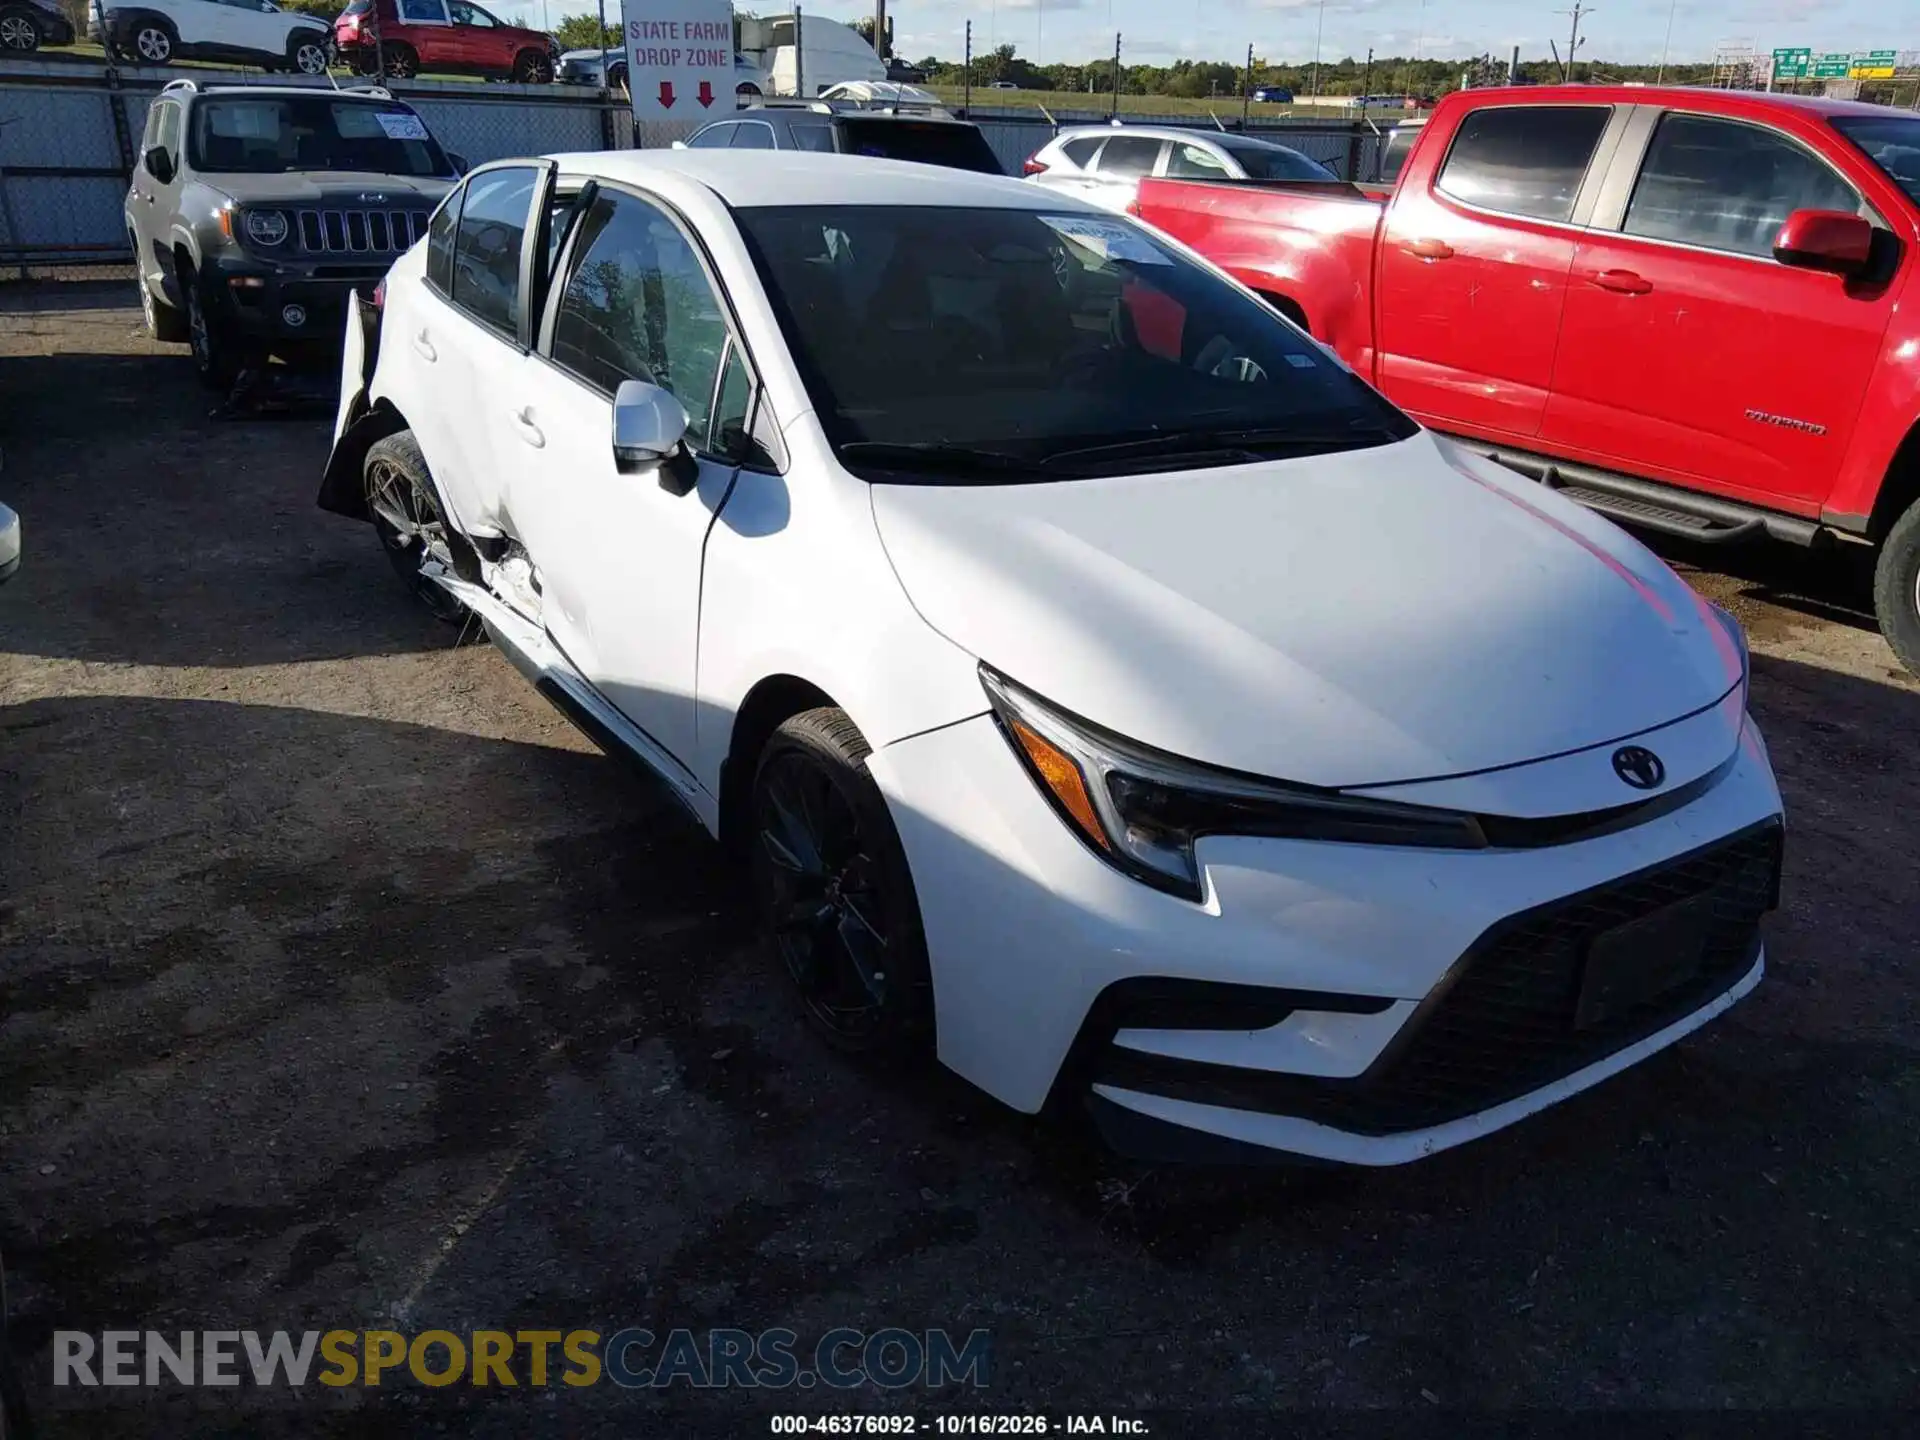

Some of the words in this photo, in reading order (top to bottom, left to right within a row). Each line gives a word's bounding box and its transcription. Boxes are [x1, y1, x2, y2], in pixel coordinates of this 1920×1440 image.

[630, 21, 679, 40] STATE
[684, 22, 729, 41] FARM
[636, 48, 680, 66] DROP
[686, 49, 728, 67] ZONE
[1744, 408, 1827, 435] COLORADO
